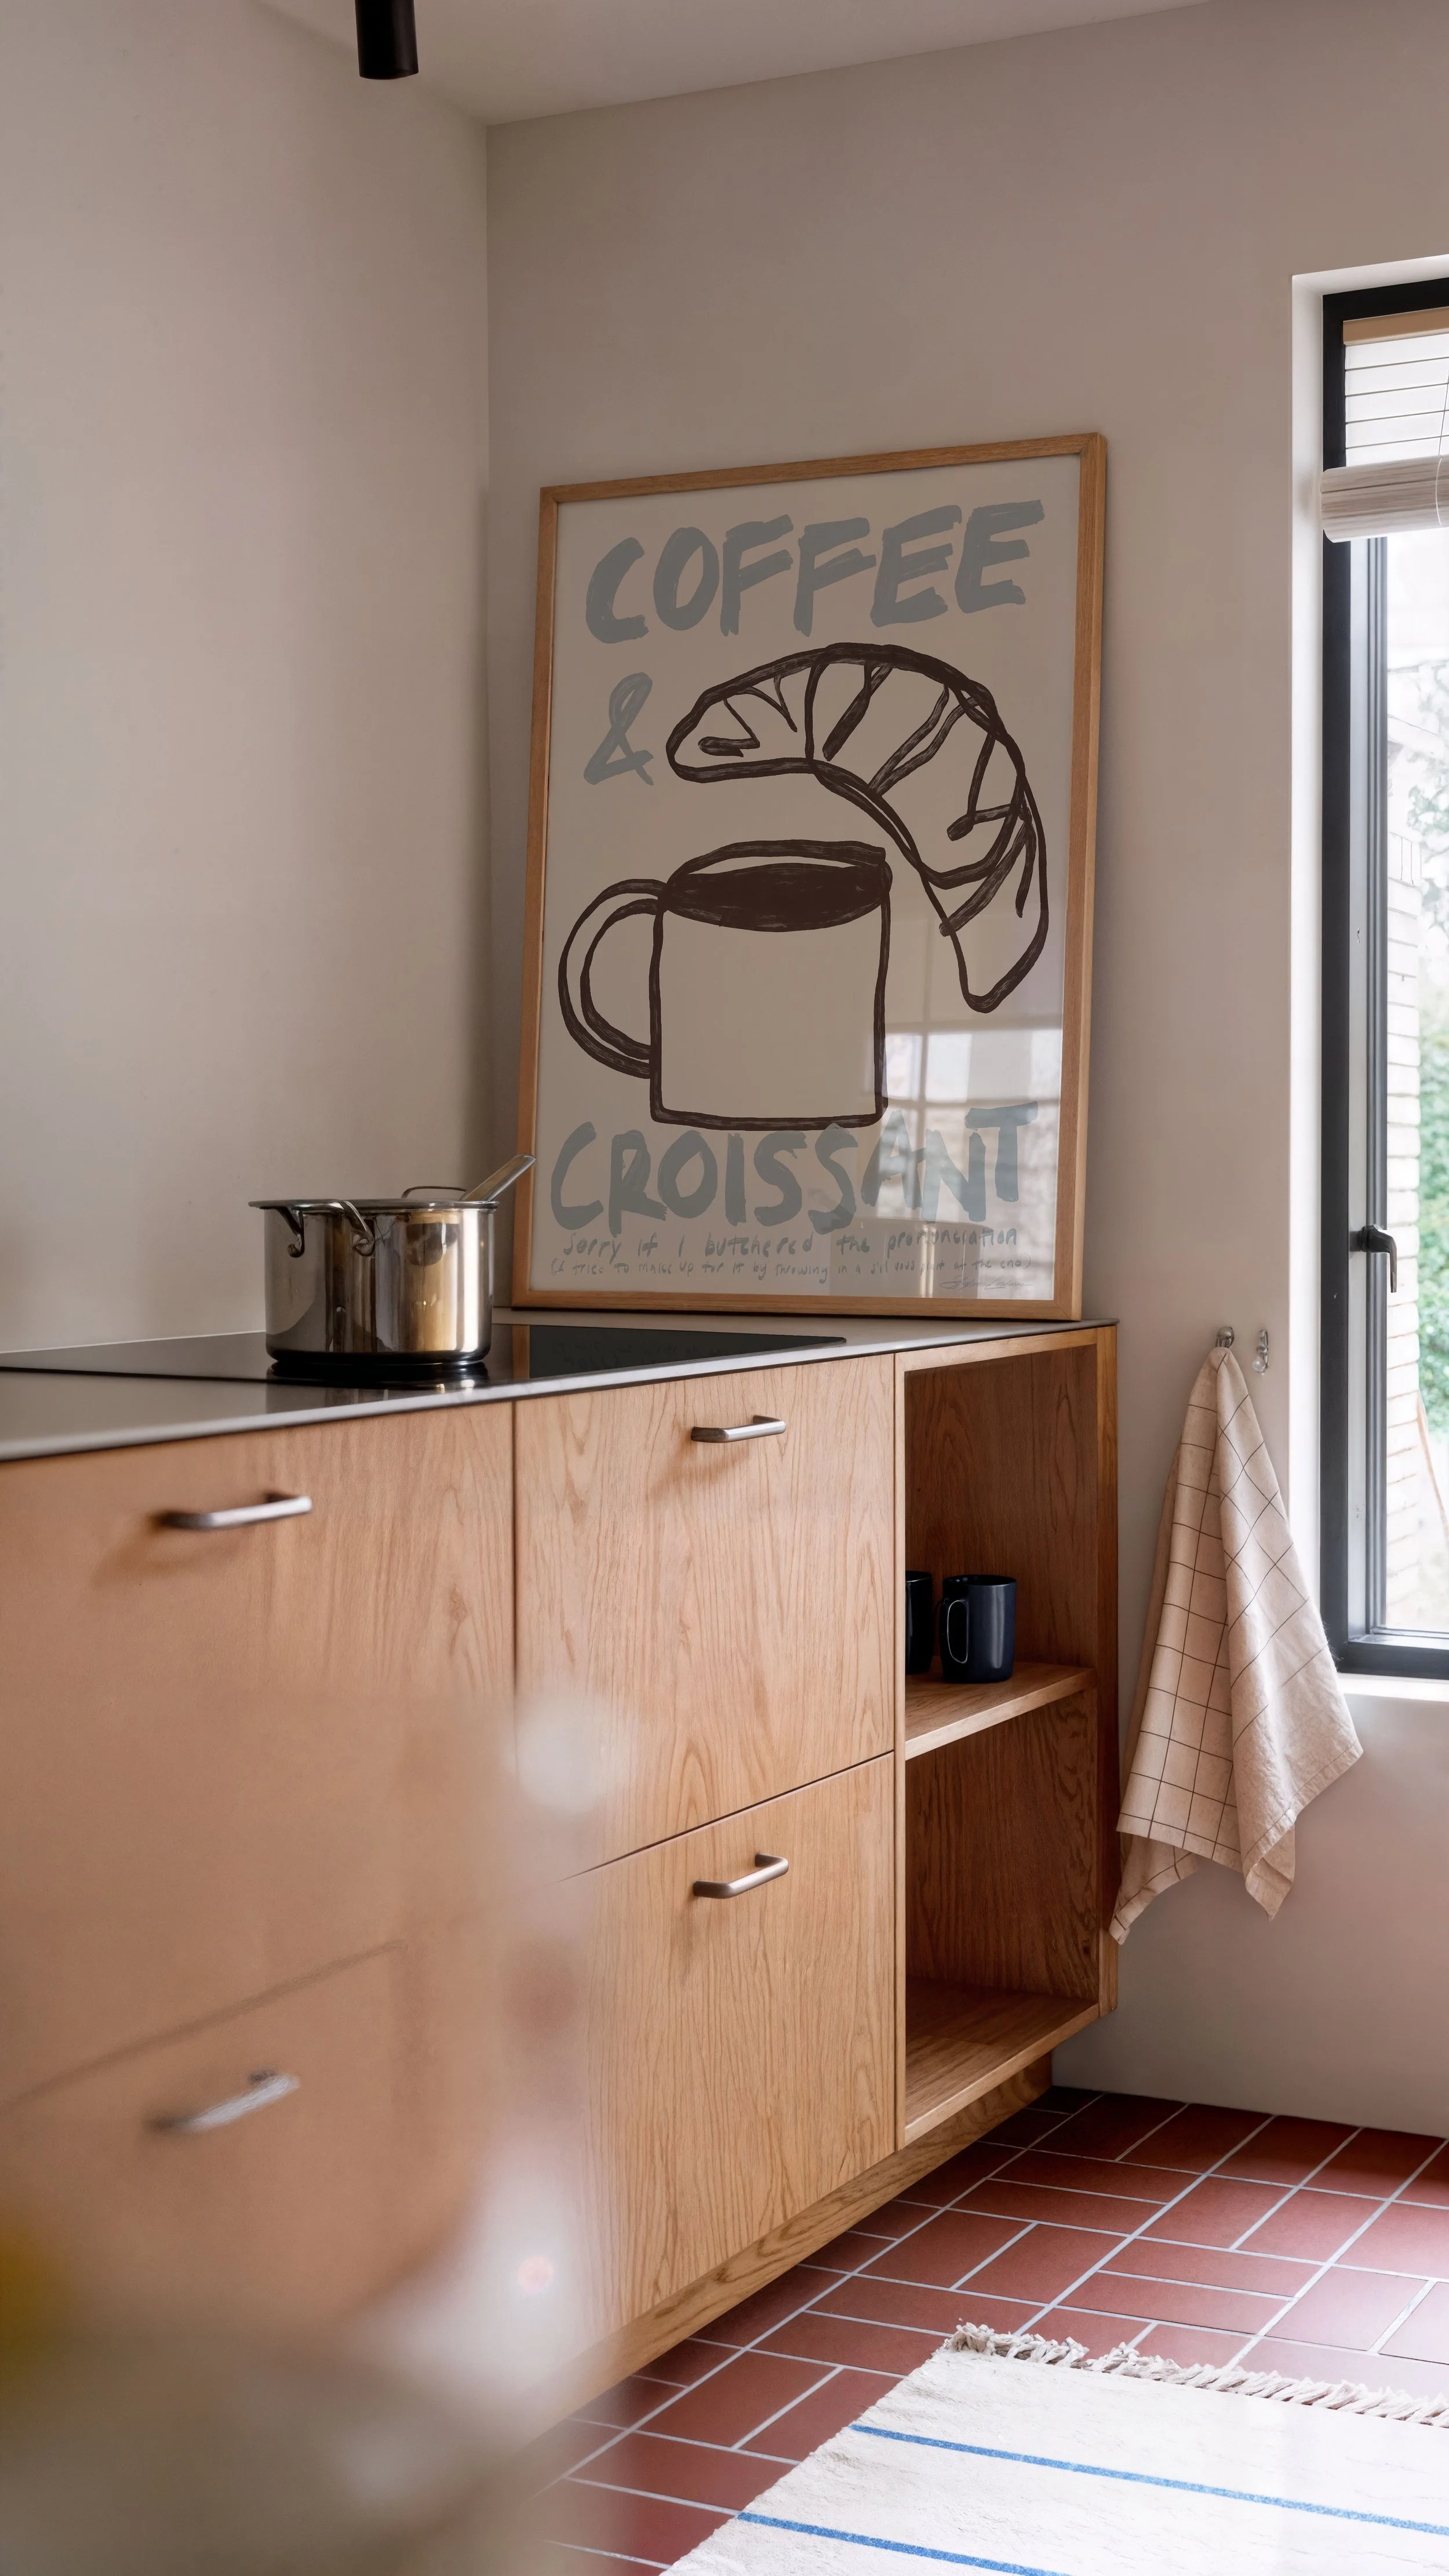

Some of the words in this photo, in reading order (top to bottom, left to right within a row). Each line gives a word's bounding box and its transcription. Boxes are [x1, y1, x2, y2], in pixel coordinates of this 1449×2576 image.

[585, 500, 1044, 643] COFFEE
[584, 672, 654, 785] &
[551, 1101, 1038, 1237] CROISSANT
[563, 1232, 622, 1265] Sorry
[678, 1234, 685, 1257] I
[705, 1231, 814, 1257] butchered
[835, 1233, 870, 1255] the
[887, 1228, 1017, 1258] pronunciation
[572, 1260, 604, 1275] tried
[614, 1262, 629, 1274] to
[638, 1262, 673, 1275] make
[679, 1260, 694, 1278] up
[701, 1261, 724, 1274] for
[733, 1262, 745, 1275] it
[753, 1261, 767, 1280] by
[776, 1262, 828, 1284] throwing
[838, 1265, 848, 1275] in
[855, 1264, 861, 1275] a
[894, 1260, 915, 1272] vous
[954, 1258, 967, 1271] at
[972, 1258, 992, 1271] the
